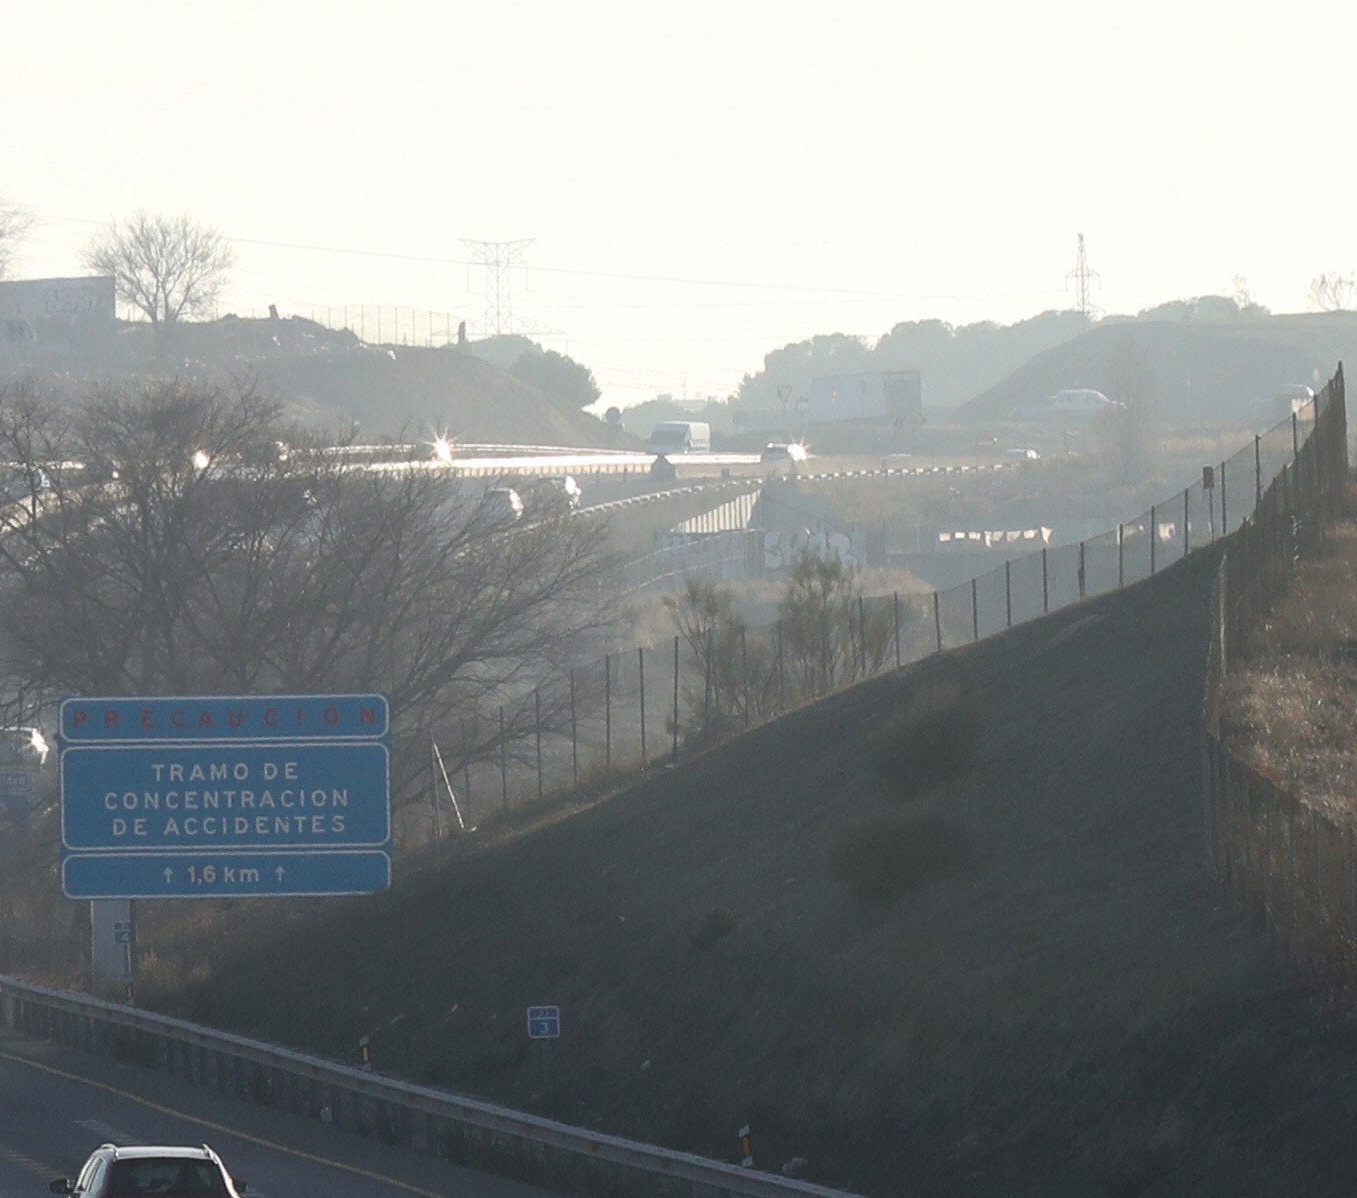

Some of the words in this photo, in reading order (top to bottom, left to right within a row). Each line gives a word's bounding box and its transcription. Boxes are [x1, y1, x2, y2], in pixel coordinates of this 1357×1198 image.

[72, 705, 377, 729] PRECAUCIÓN
[151, 763, 250, 782] TRAMO
[263, 762, 299, 781] DE
[104, 788, 349, 810] CONCENTRACION
[112, 817, 148, 836] DE
[163, 815, 345, 836] ACCIDENTES
[187, 865, 217, 884] 1,6
[223, 866, 260, 883] km
